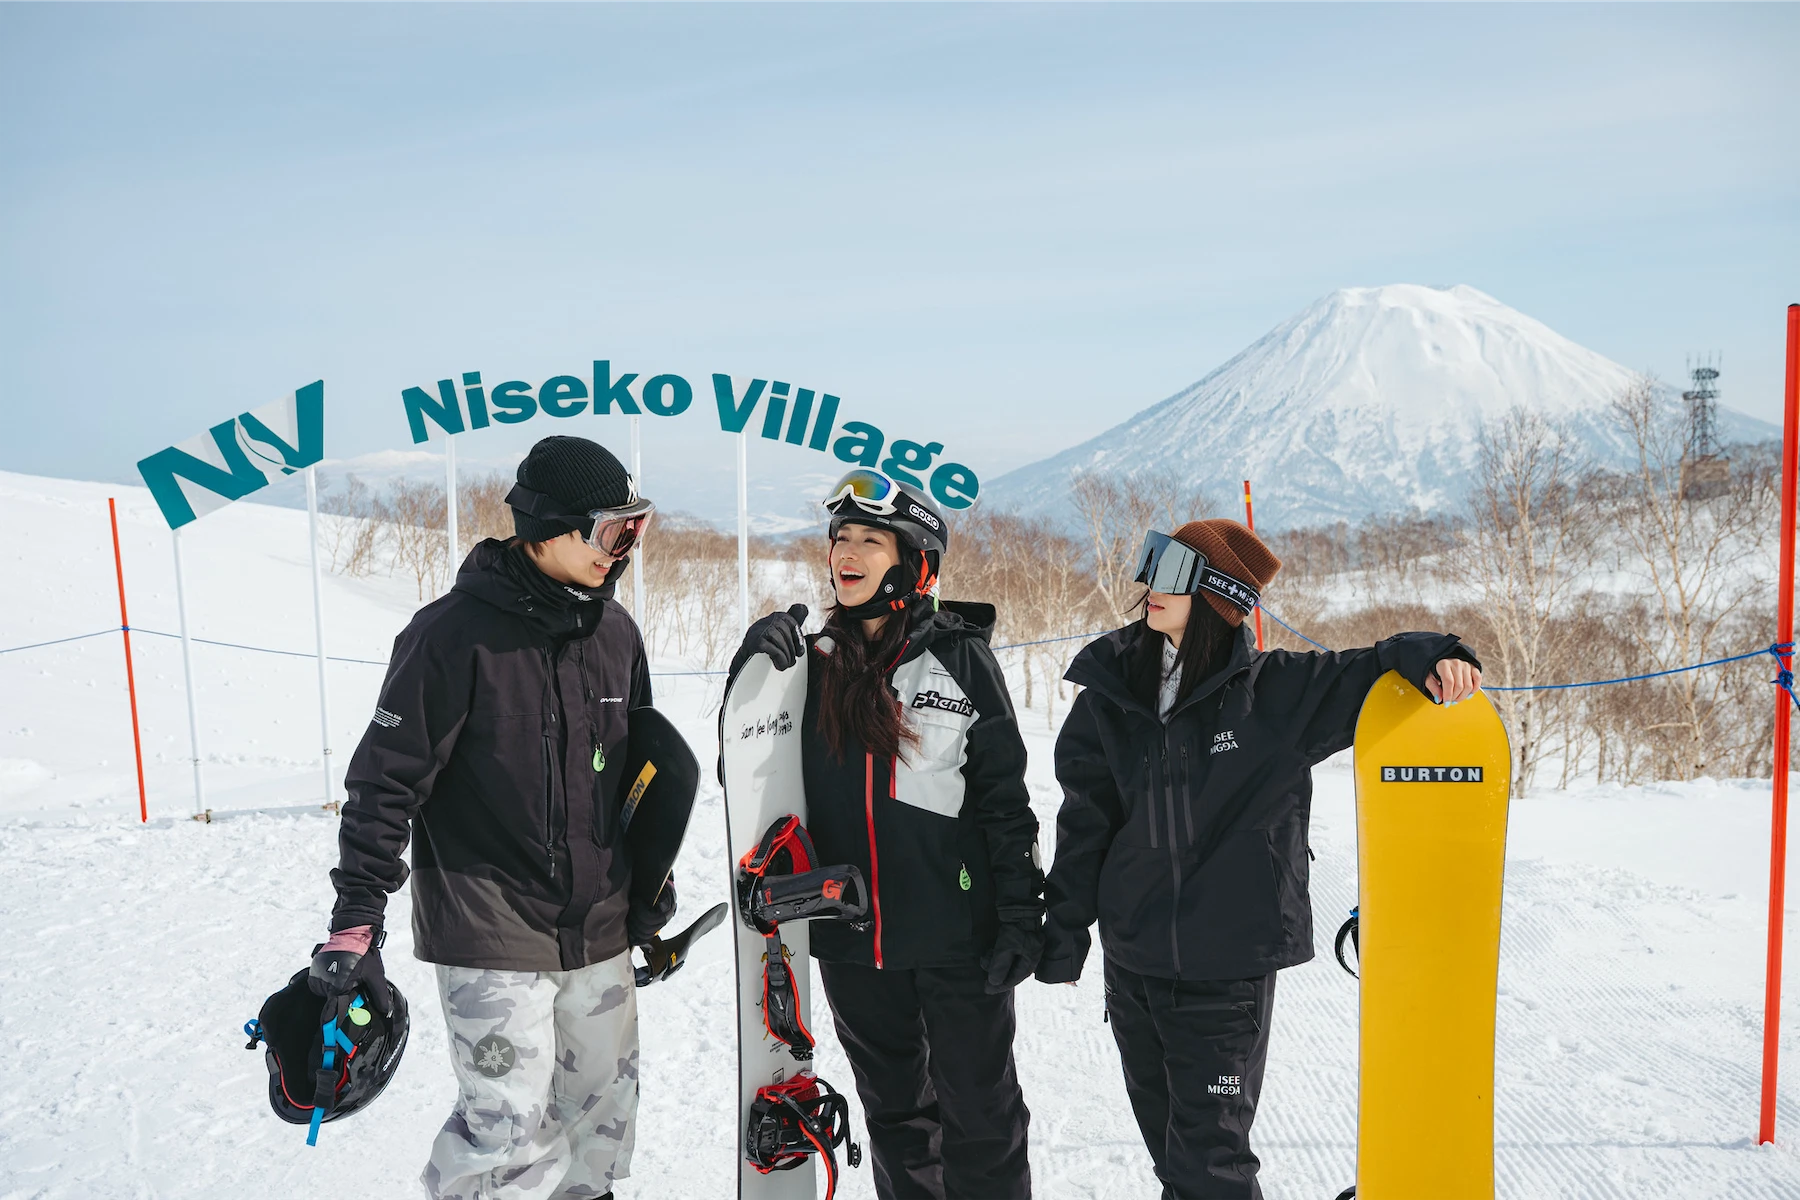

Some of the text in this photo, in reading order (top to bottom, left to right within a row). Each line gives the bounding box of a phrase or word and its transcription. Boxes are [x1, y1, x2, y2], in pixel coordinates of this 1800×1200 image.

[401, 360, 980, 510] Niseko Village
[137, 379, 324, 530] NV
[1208, 575, 1229, 590] ISEE
[1213, 730, 1235, 744] ISEE
[1383, 767, 1481, 782] BURTON
[1218, 1075, 1241, 1085] ISEE
